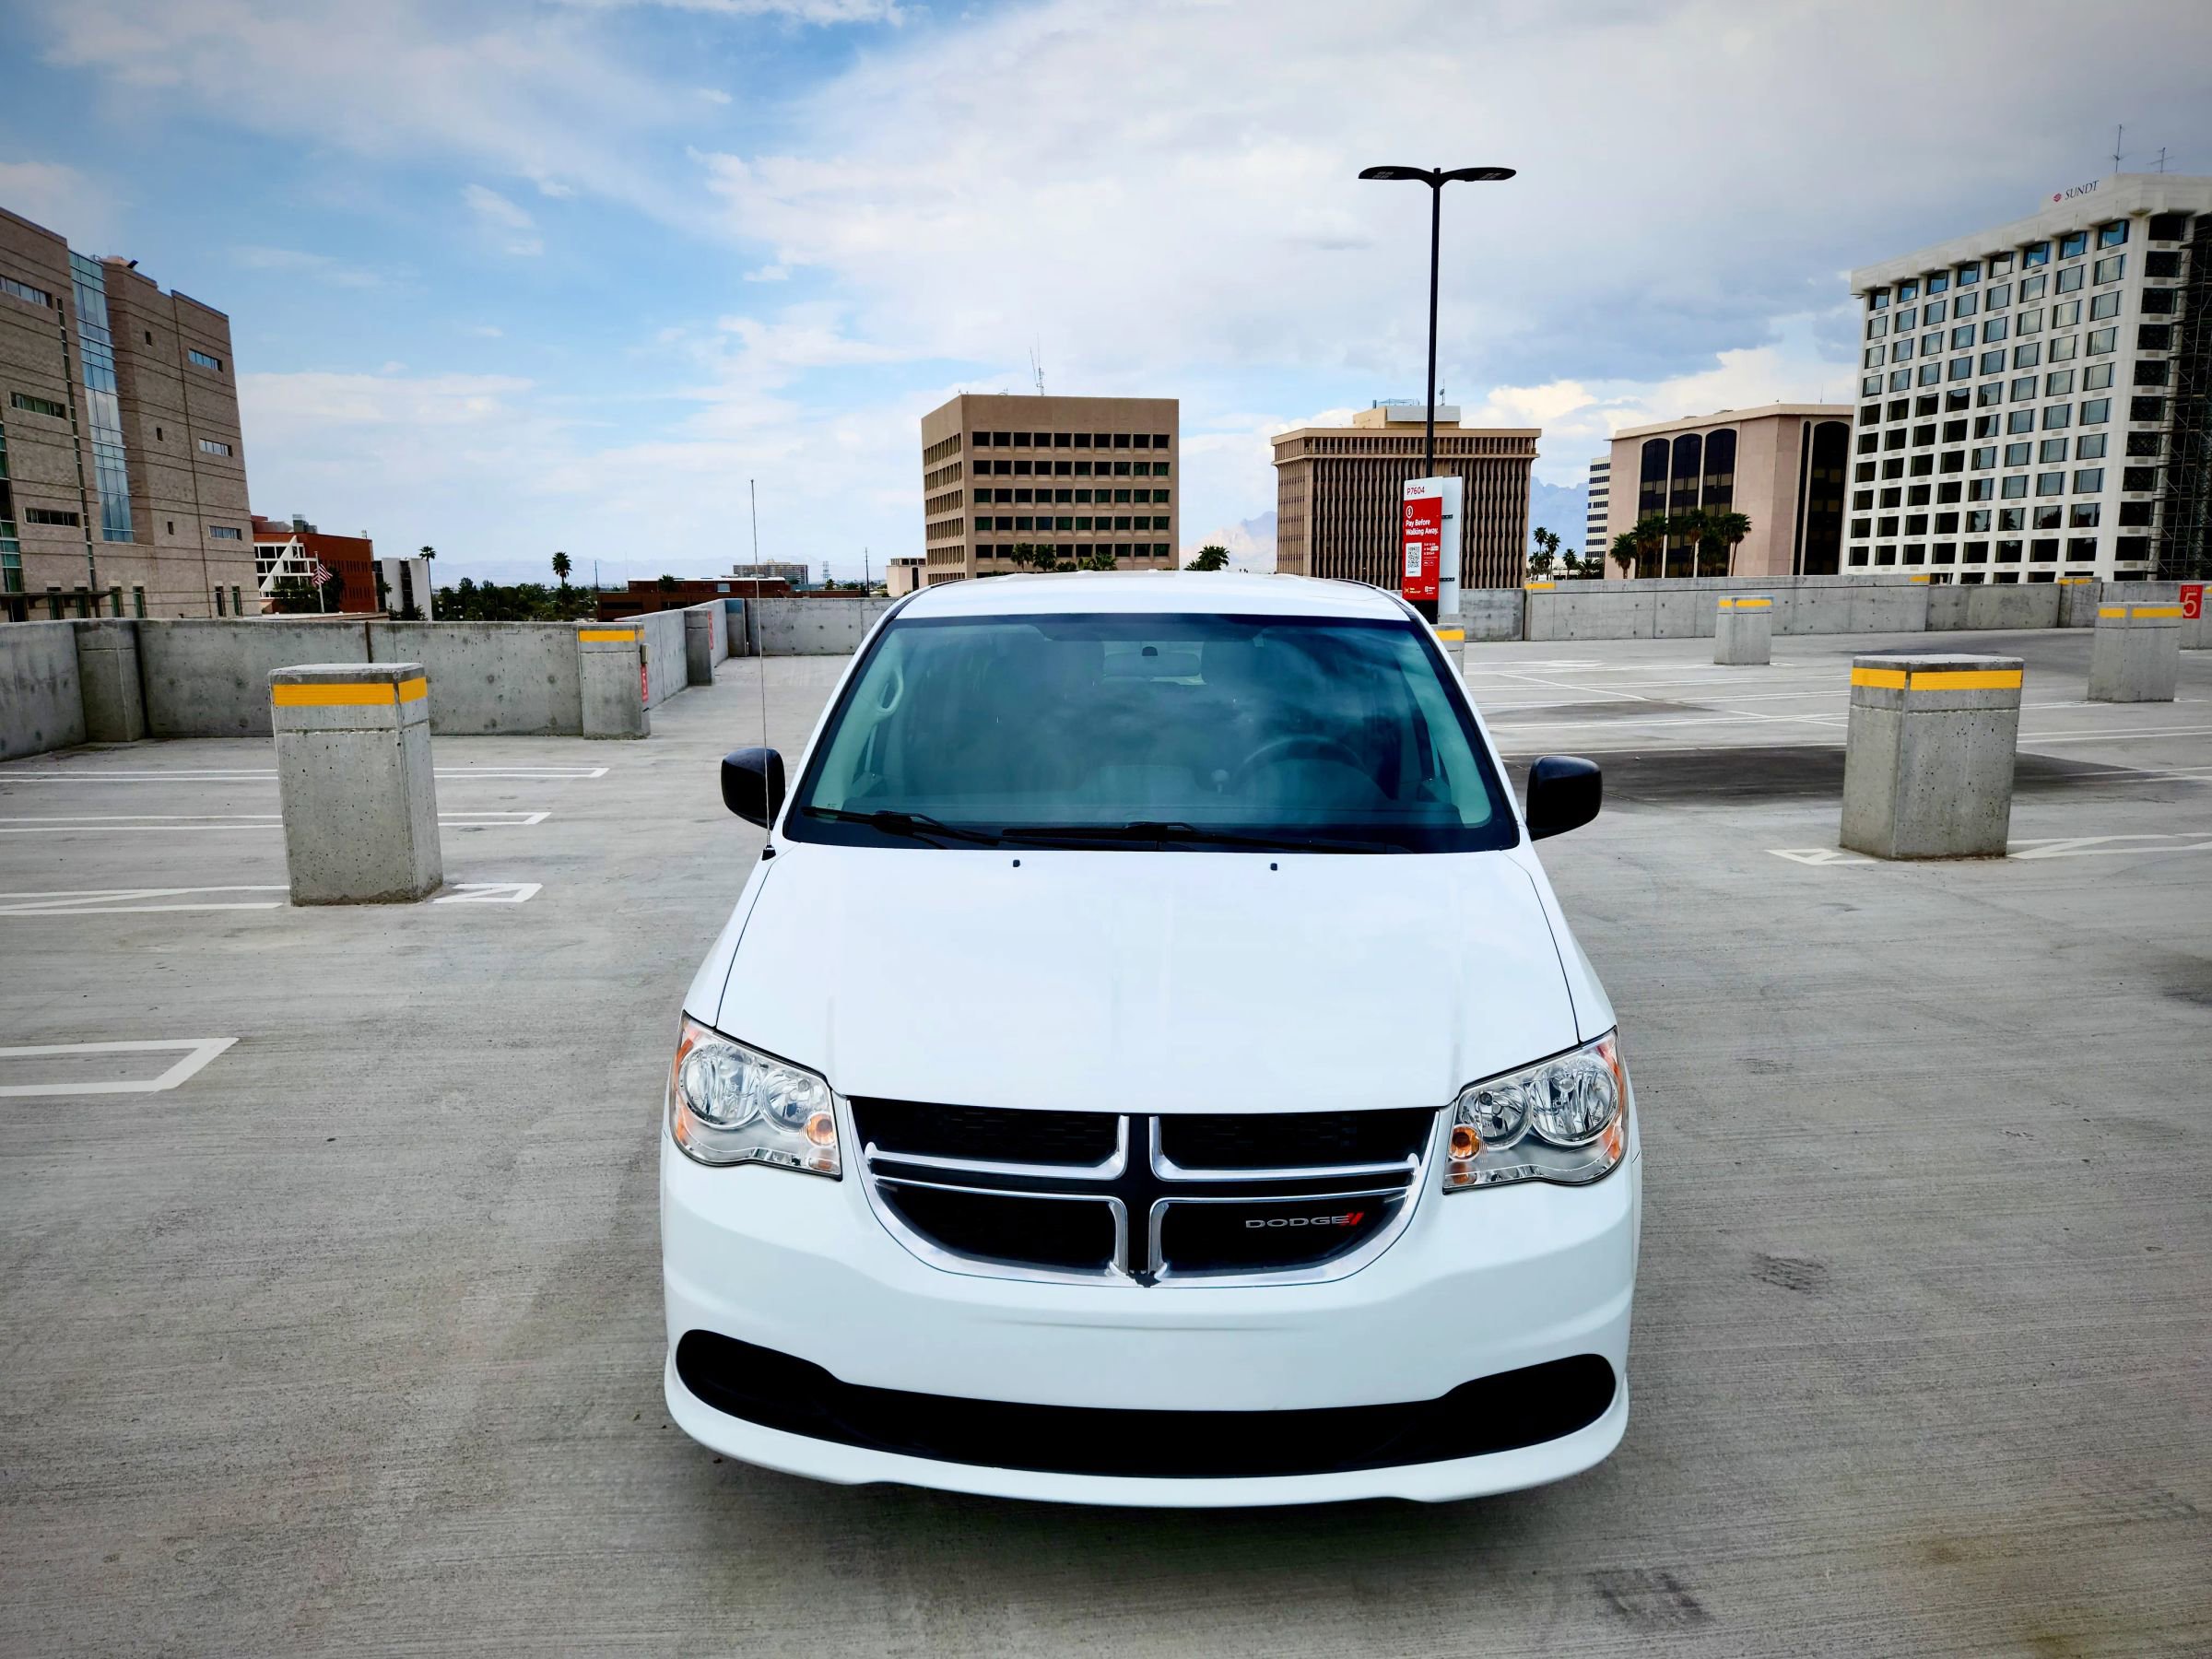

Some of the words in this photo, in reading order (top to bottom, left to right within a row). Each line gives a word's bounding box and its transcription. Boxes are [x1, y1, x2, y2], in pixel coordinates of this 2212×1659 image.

[2065, 180, 2100, 200] SUNDT
[1406, 487, 1425, 495] P7604
[2183, 592, 2197, 617] 5
[1245, 1216, 1350, 1228] DODGE
